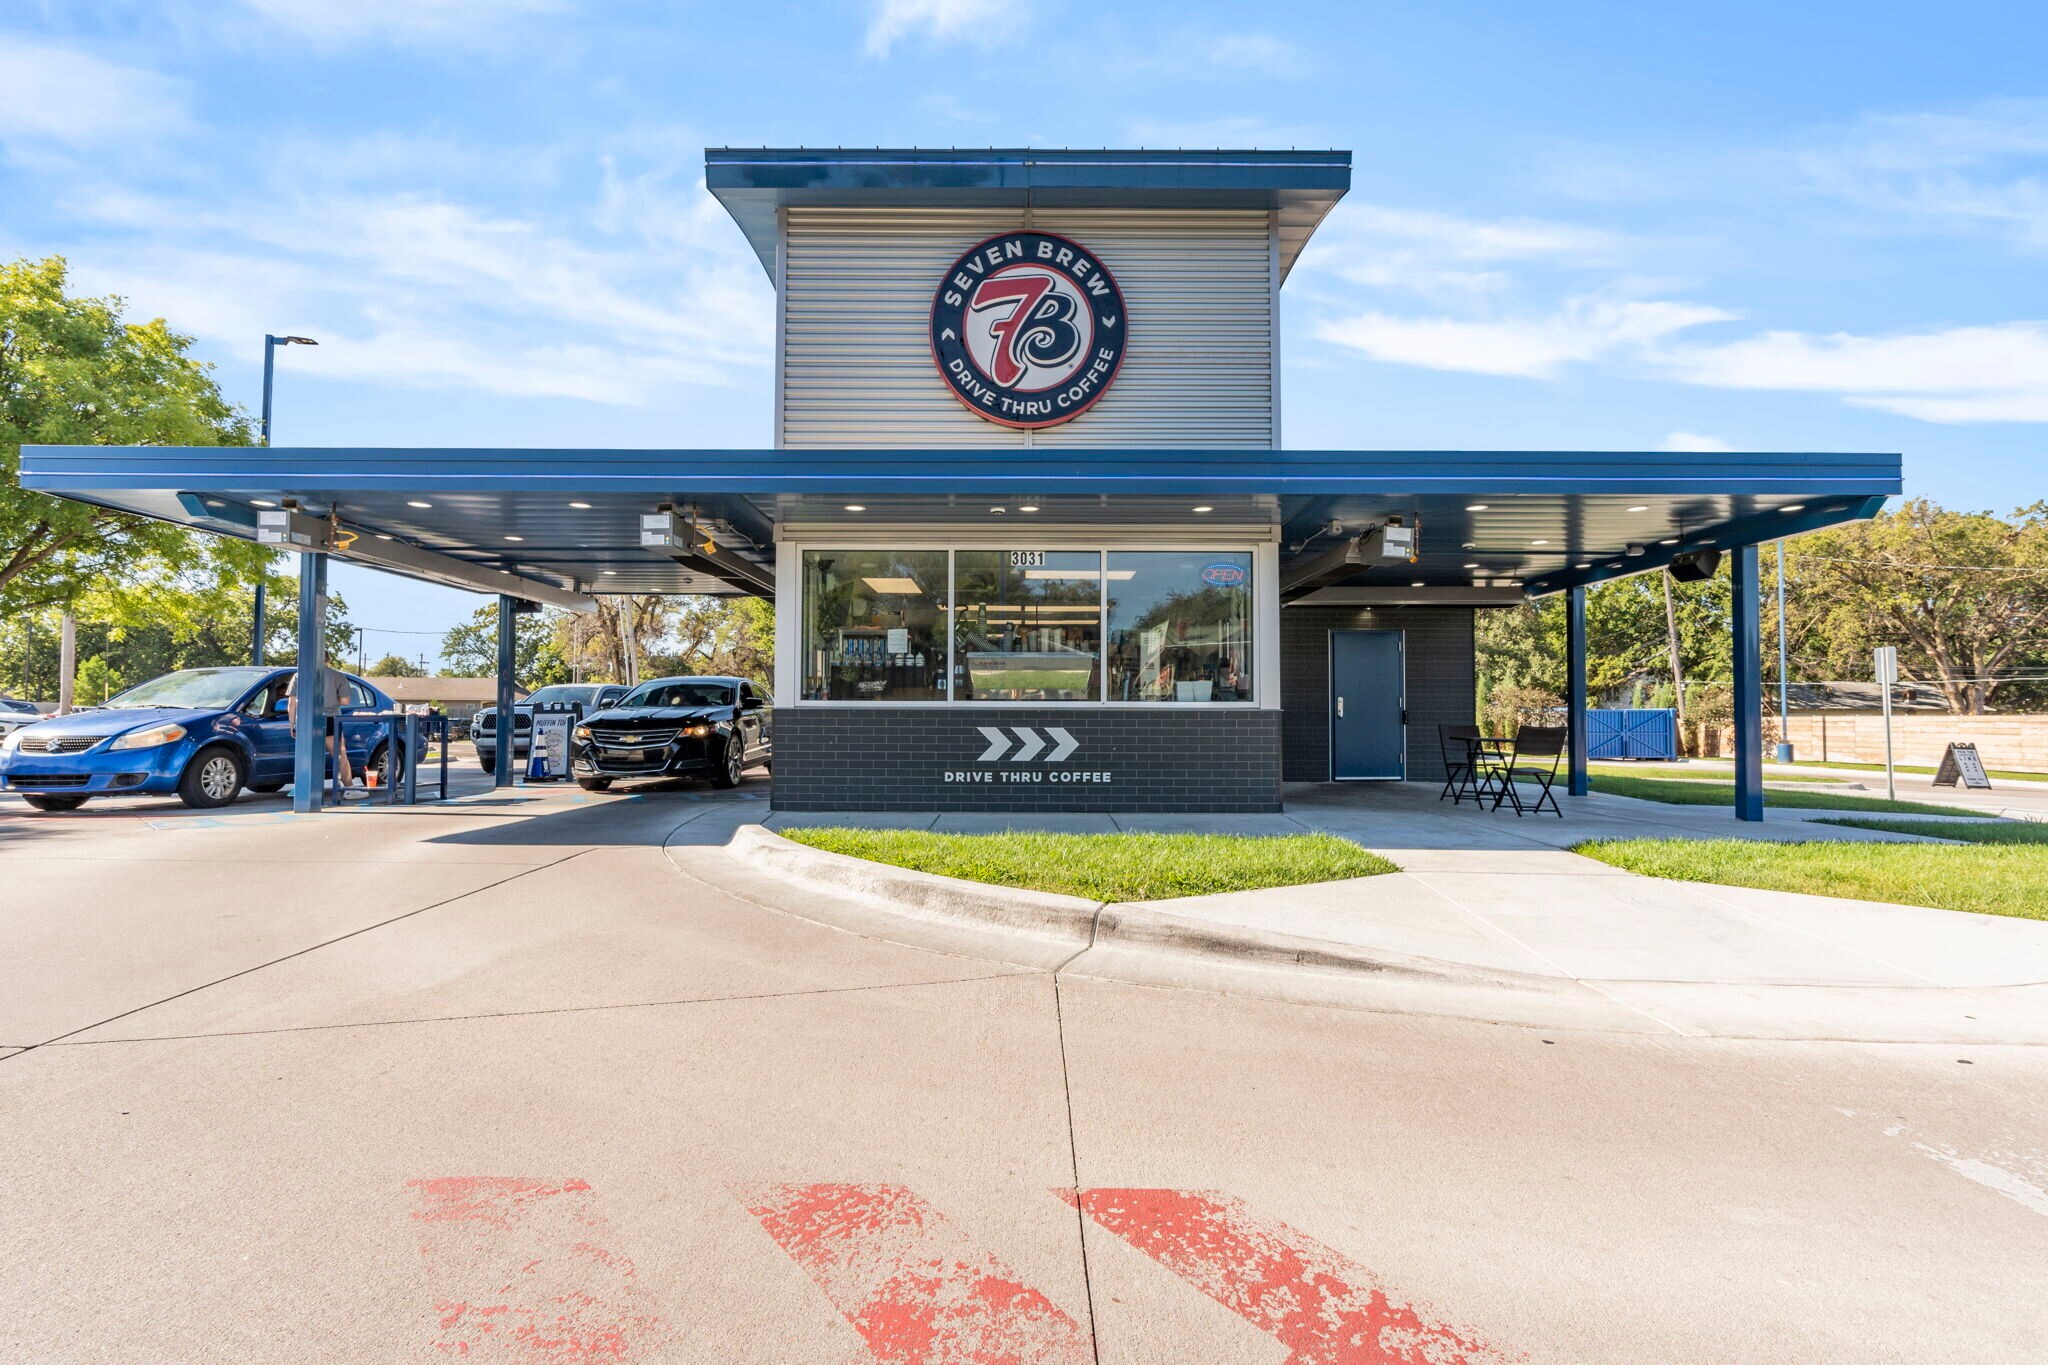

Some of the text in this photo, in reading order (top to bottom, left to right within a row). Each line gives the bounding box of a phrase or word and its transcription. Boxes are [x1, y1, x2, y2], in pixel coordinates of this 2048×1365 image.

[944, 240, 1110, 307] SEVEN BREW
[949, 347, 1114, 415] DRIVE THRU COFFEE
[1012, 552, 1043, 565] 3031
[1202, 568, 1244, 581] OPEN
[944, 772, 1112, 783] DRIVE THRU COFFEE
